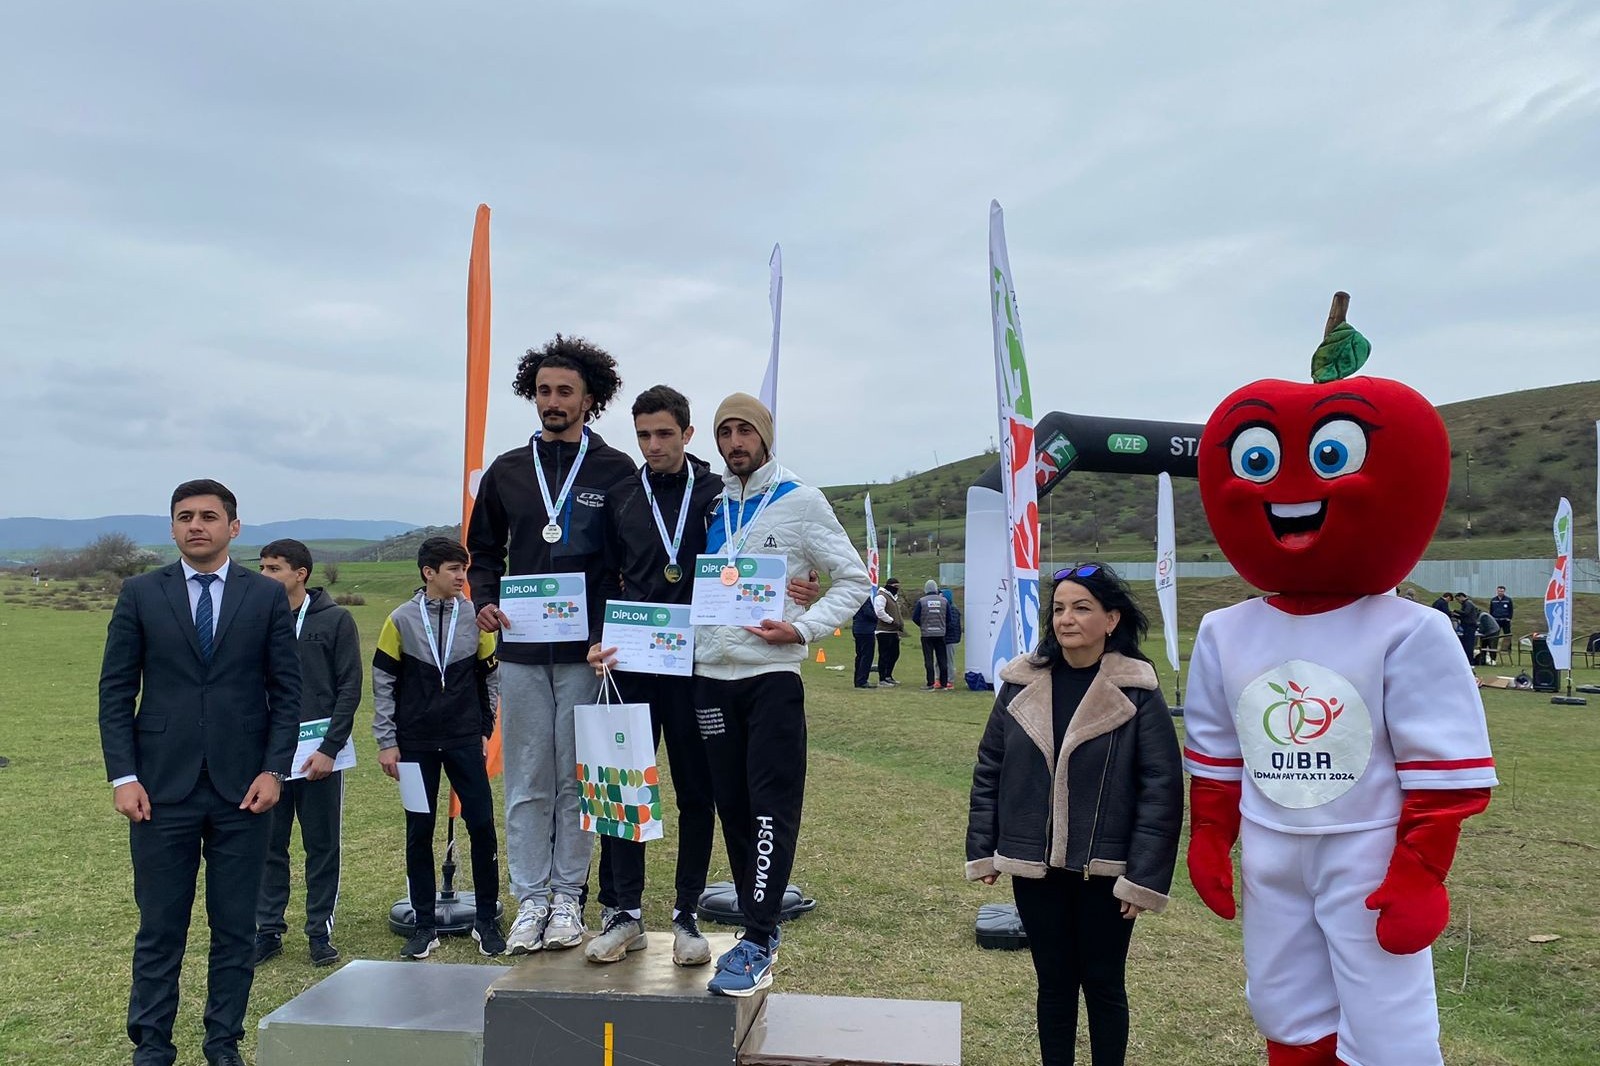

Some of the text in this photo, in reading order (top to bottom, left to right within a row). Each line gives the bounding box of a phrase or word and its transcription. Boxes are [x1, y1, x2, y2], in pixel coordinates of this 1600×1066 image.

[1114, 437, 1141, 451] AZE
[505, 584, 538, 594] DİPLOM
[611, 610, 648, 621] DİPLOM
[1272, 752, 1331, 770] QUBA
[1253, 769, 1355, 781] İDMAN PAYTAXTI 2024
[753, 815, 774, 903] SWOOSH
